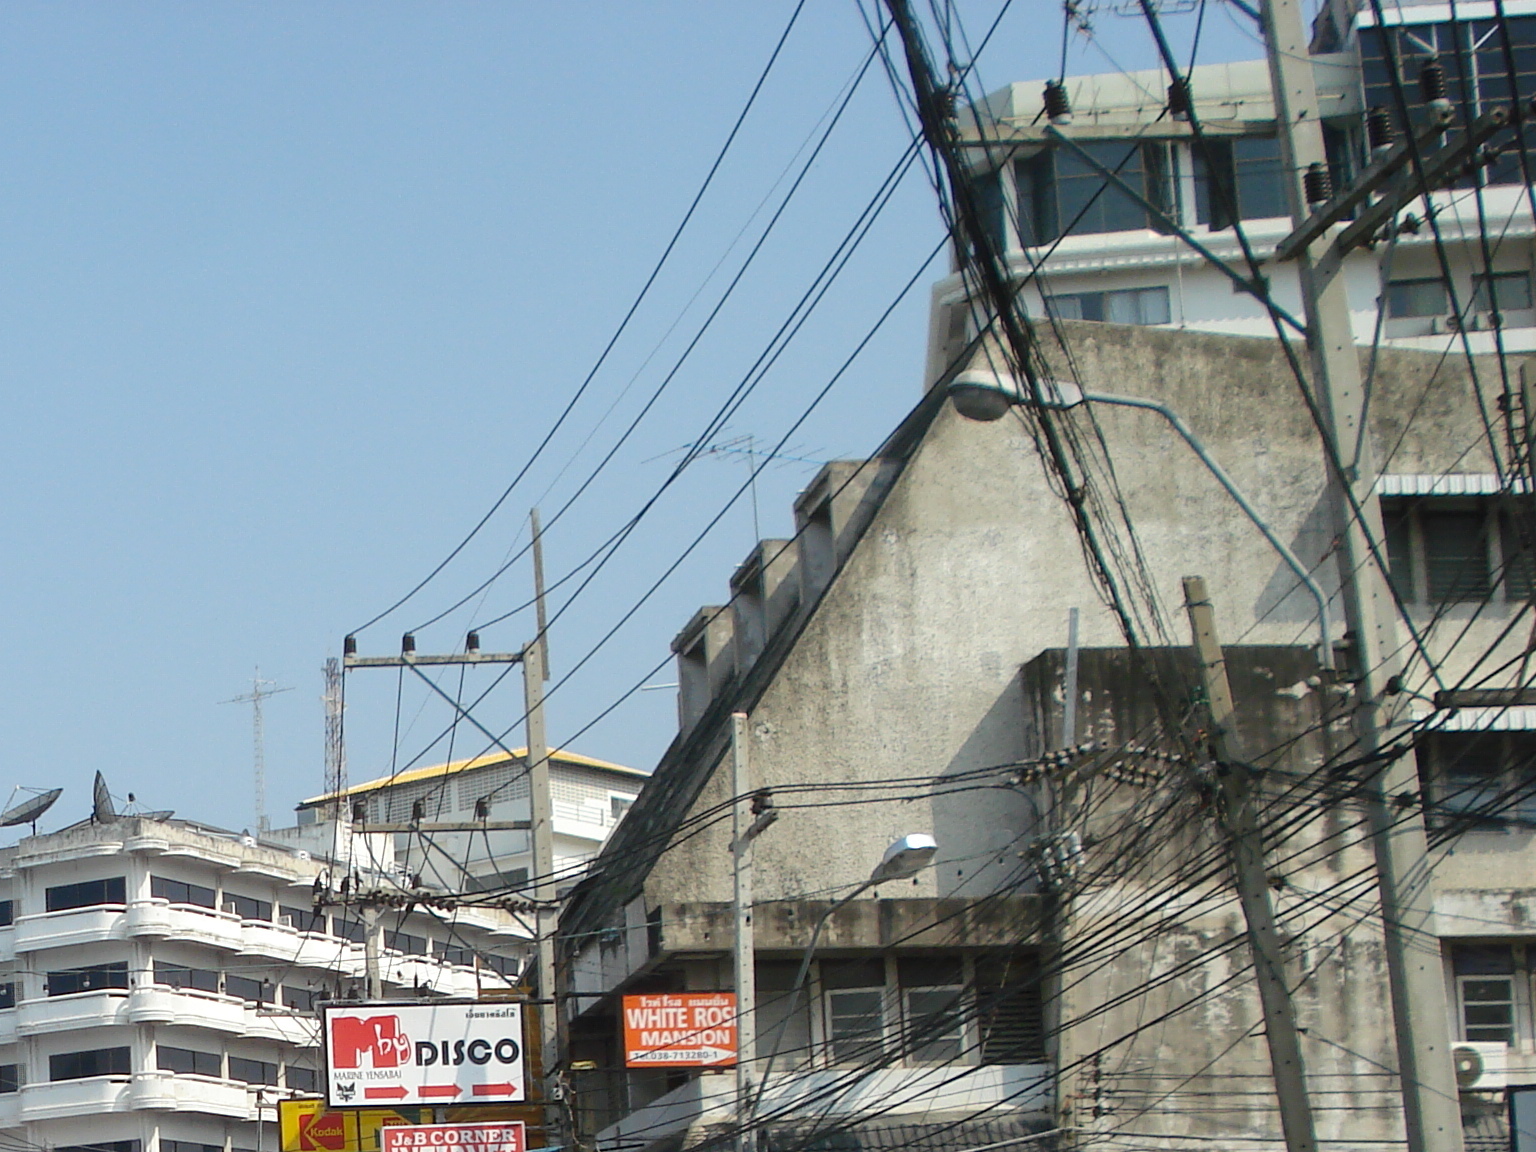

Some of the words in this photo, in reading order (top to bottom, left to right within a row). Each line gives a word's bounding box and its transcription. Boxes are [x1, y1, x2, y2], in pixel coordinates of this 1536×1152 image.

[626, 1007, 688, 1029] WHITE
[641, 1030, 730, 1046] MANSION
[415, 1038, 519, 1066] DISCO
[310, 1127, 344, 1138] Kodak
[391, 1131, 427, 1146] J&B
[430, 1129, 517, 1145] CORNER
